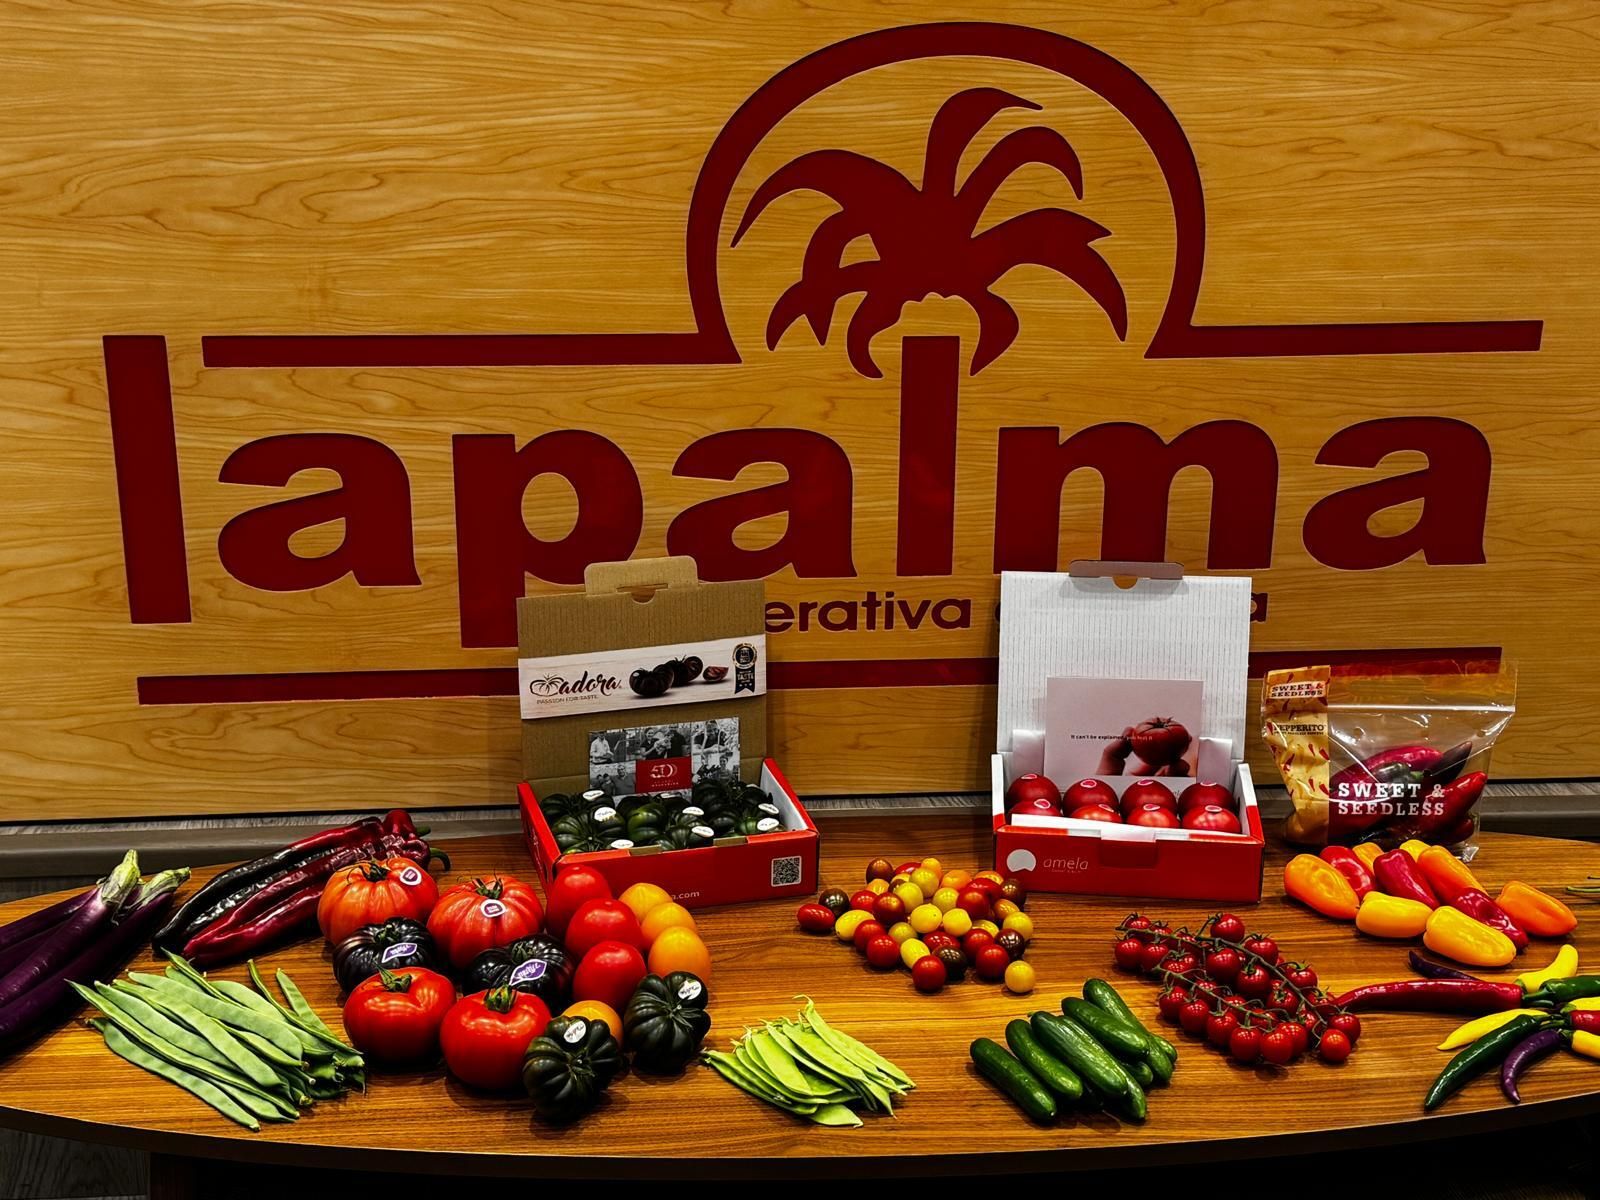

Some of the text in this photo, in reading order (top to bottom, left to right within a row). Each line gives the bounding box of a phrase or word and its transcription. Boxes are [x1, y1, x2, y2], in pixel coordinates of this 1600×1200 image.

[103, 334, 1493, 649] lapalma
[764, 590, 973, 633] erativa
[558, 670, 622, 697] adora
[1272, 682, 1324, 692] SWEET &
[536, 697, 565, 705] PASSION
[1338, 782, 1445, 798] SWEET &
[1338, 801, 1445, 816] SEEDLESS
[1043, 856, 1089, 871] amela
